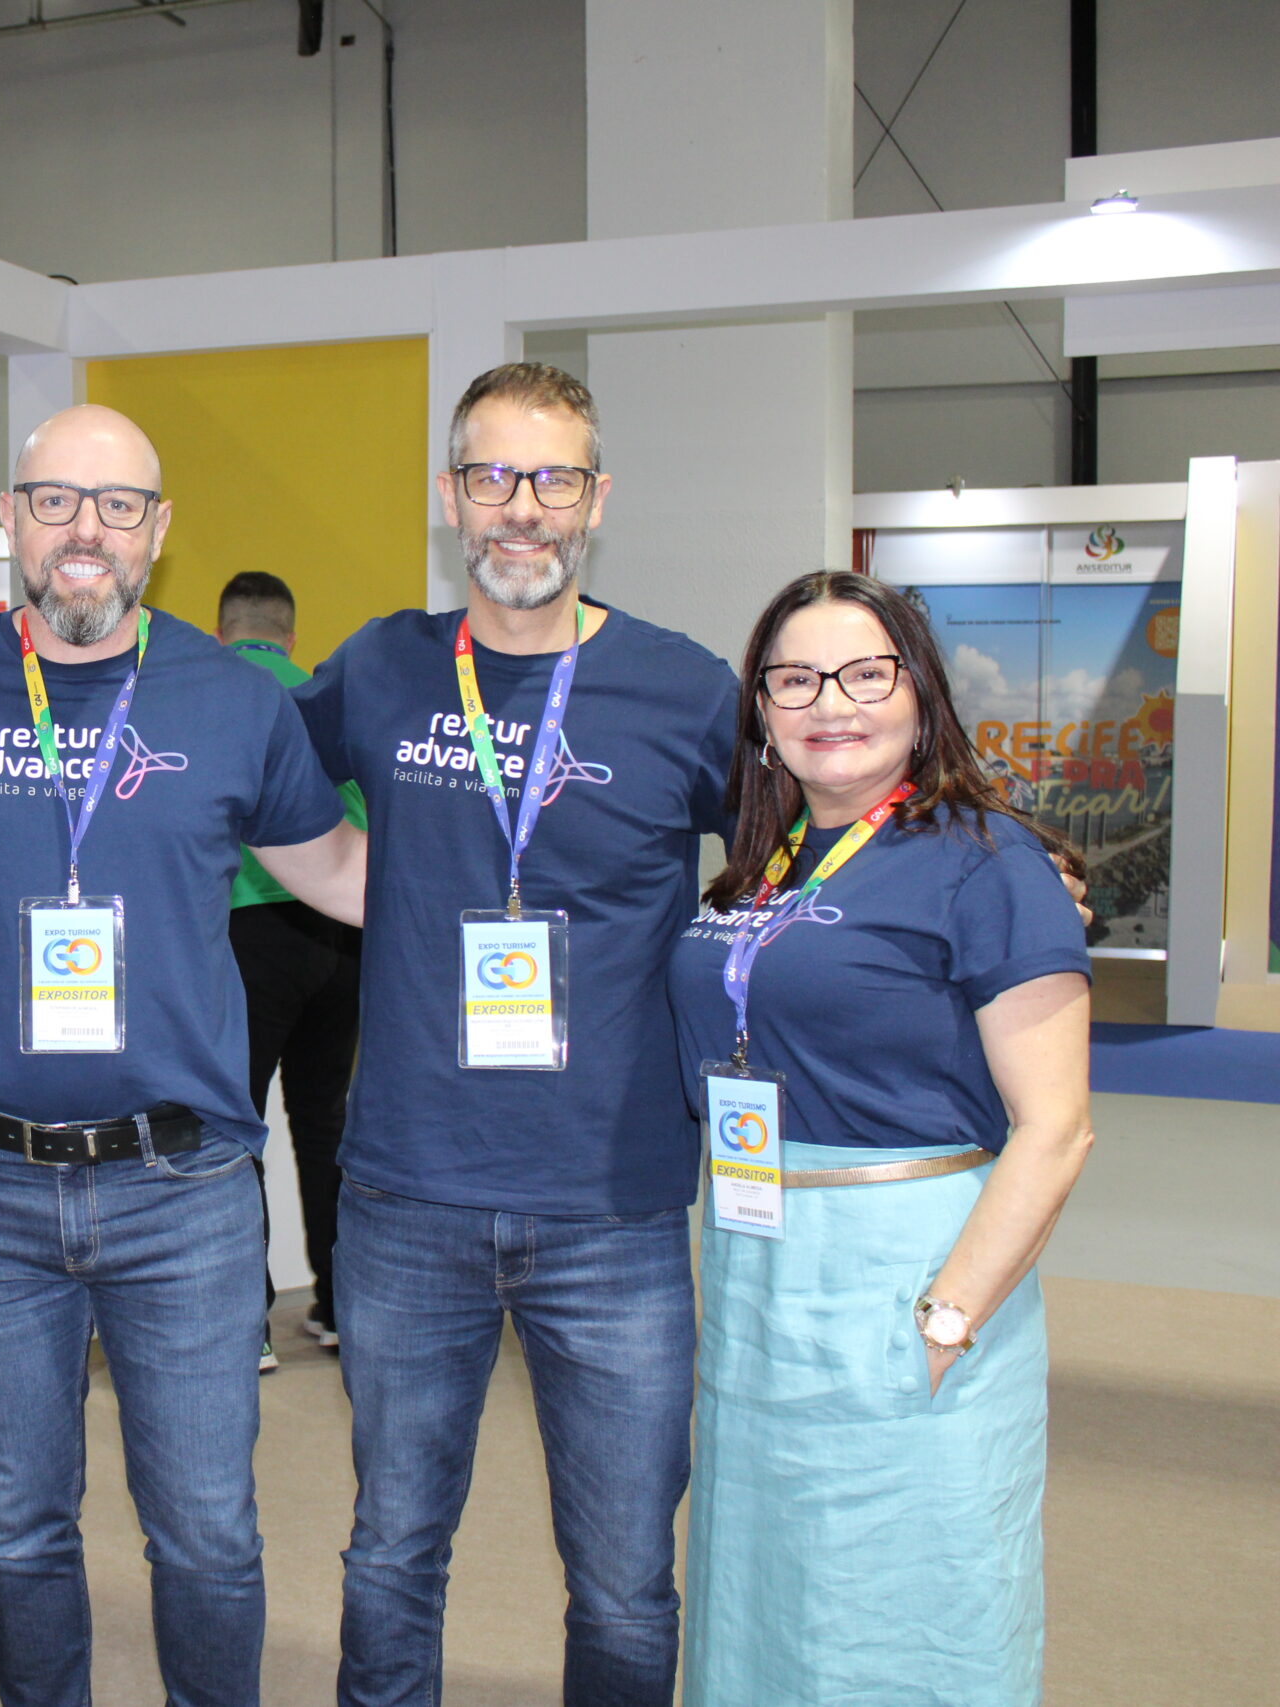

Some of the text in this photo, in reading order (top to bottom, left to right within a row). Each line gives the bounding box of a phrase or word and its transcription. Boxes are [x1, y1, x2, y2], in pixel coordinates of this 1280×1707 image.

[449, 778, 457, 789] a
[27, 786, 36, 796] a
[38, 990, 108, 1000] EXPOSITOR
[473, 1004, 545, 1015] EXPOSITOR
[720, 1099, 766, 1111] EXPO TURISMO
[717, 1165, 775, 1183] EXPOSITOR
